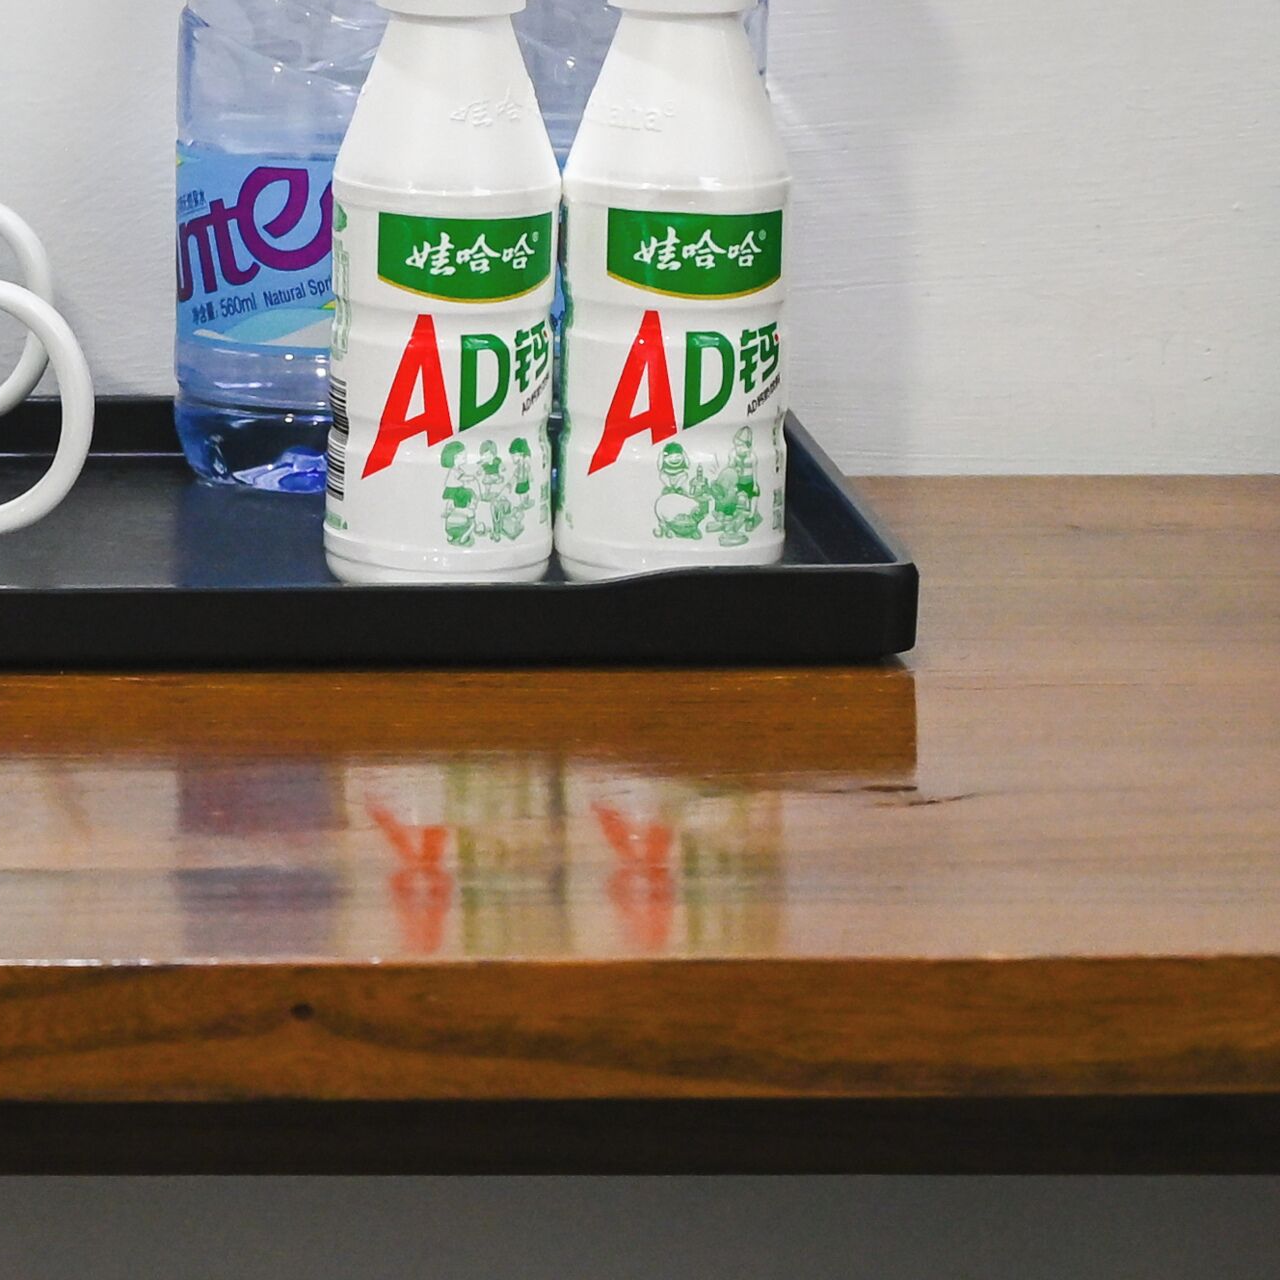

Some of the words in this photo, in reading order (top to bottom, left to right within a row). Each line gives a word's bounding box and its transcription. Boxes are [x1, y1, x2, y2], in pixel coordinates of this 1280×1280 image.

[405, 231, 536, 276] 娃哈哈
[633, 226, 763, 271] 娃哈哈
[219, 292, 257, 318] 560ml
[263, 282, 307, 307] Natural
